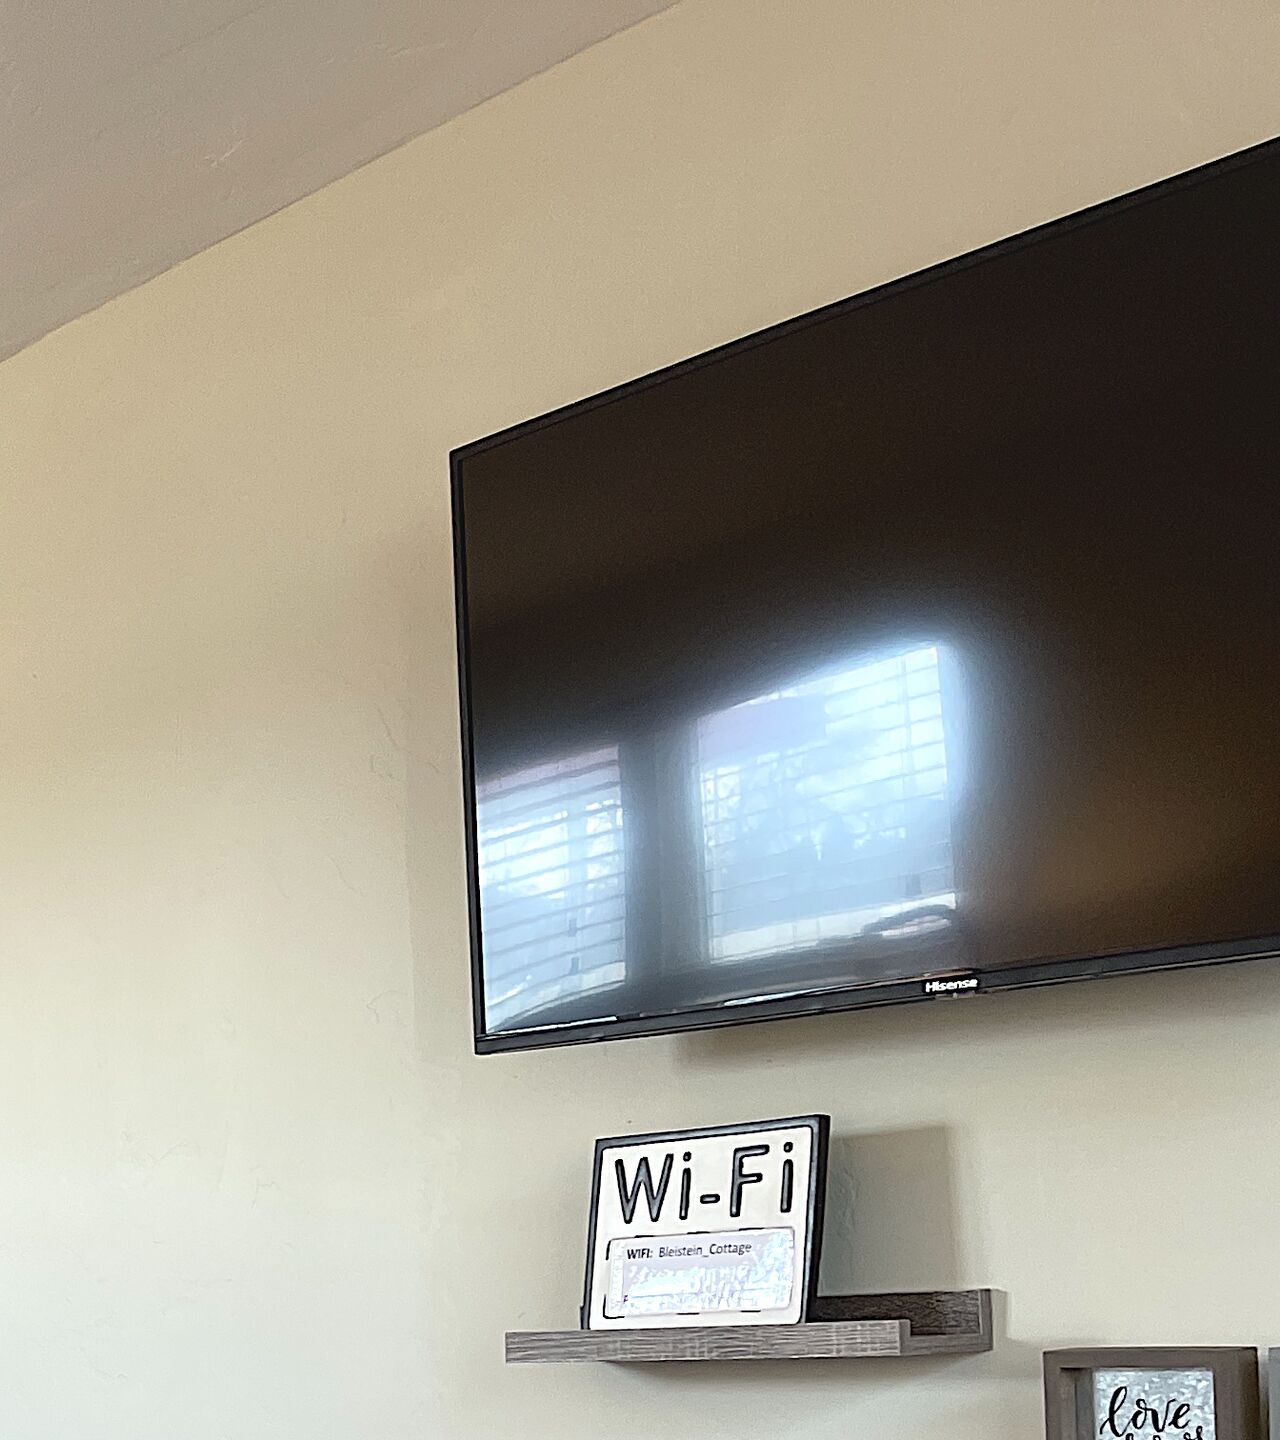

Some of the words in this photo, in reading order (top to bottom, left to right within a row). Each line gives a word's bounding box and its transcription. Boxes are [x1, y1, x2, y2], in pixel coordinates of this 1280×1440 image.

[925, 979, 978, 993] Hisense
[614, 1141, 794, 1224] Wi-Fi
[627, 1248, 654, 1260] WIFI:
[1100, 1386, 1191, 1437] love
